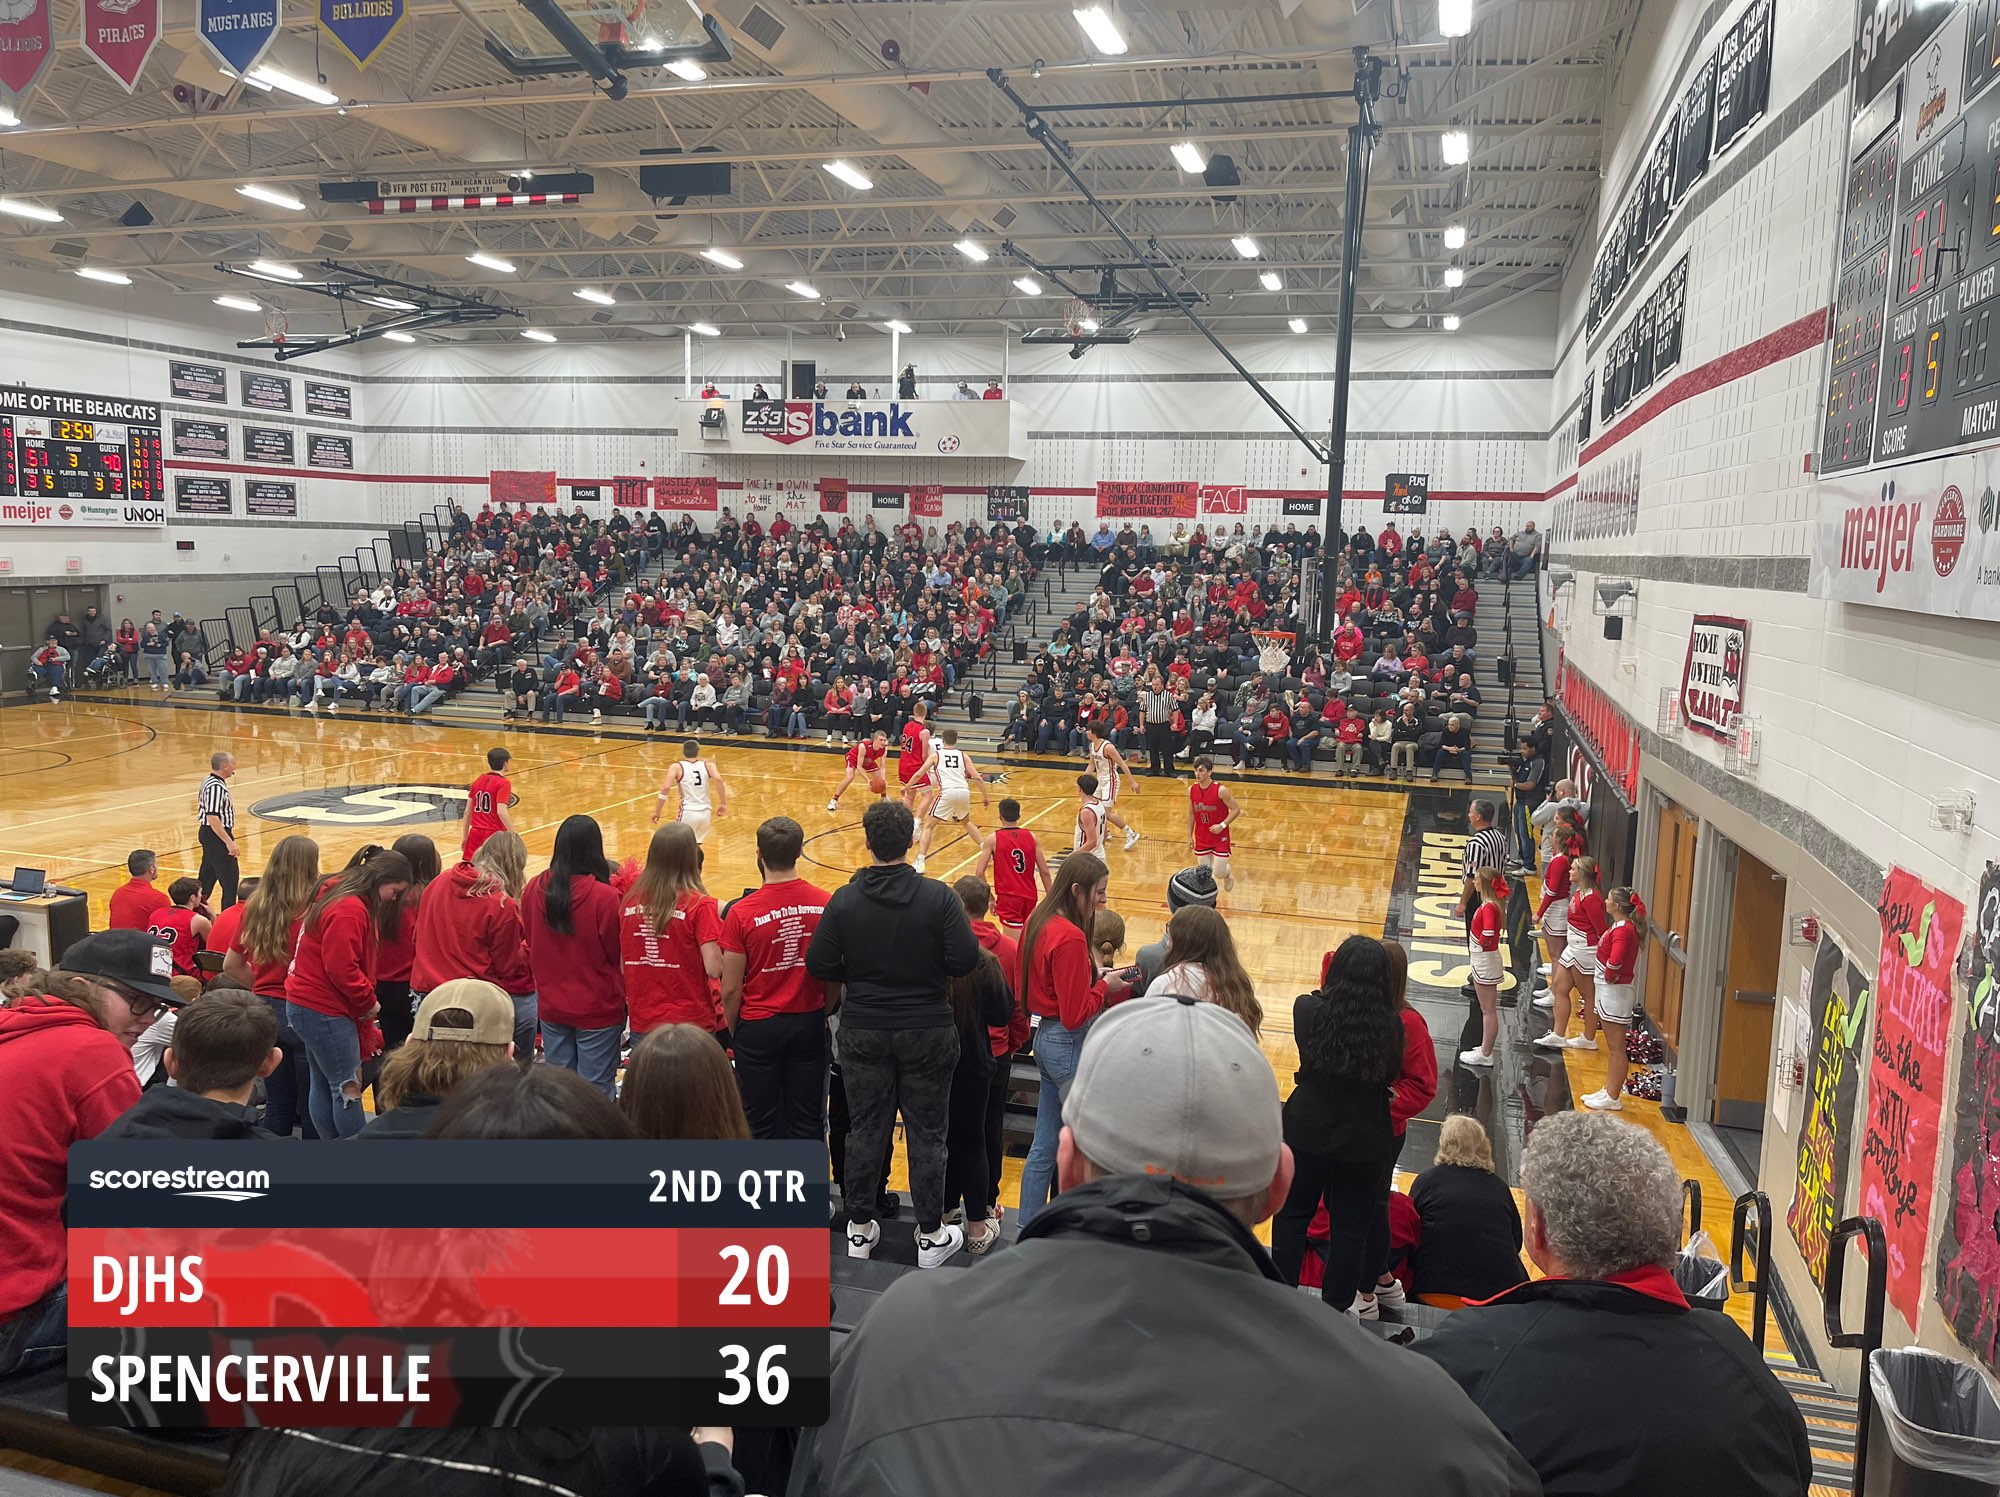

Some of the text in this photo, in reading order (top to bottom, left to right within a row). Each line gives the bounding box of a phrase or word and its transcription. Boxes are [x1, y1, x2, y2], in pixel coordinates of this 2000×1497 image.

[332, 1, 394, 21] BULLDOGS
[207, 12, 273, 33] MUSTANGS
[98, 24, 145, 43] PIRATES
[1911, 139, 1947, 201] HOME
[393, 182, 447, 193] VFW POST 6772
[450, 178, 482, 186] AMERICAN
[1958, 266, 1995, 310] PLAYER
[1893, 307, 1918, 342] FOULS
[0, 391, 157, 421] ME OF THE BEARCATS
[815, 403, 914, 437] bank
[1962, 400, 1998, 436] MATCH
[60, 421, 93, 440] 2:54
[25, 439, 45, 448] HOME
[100, 444, 120, 453] GUEST
[815, 440, 918, 450] Five Star Service Guaranteed
[1882, 425, 1908, 456] SCORE
[26, 448, 48, 467] 51
[69, 453, 78, 467] 3
[45, 475, 54, 489] 5
[95, 478, 104, 491] 3
[786, 480, 809, 490] OWN
[927, 486, 941, 494] OUT
[786, 490, 806, 500] the
[877, 497, 899, 505] HOME
[3, 501, 51, 523] meijer
[87, 506, 118, 515] Huntington
[124, 506, 164, 522] UNOH
[785, 501, 807, 509] MAT
[1102, 507, 1119, 516] BOYS
[1119, 507, 1157, 516] BASKETBALL
[1289, 503, 1314, 511] HOME
[1841, 480, 1921, 593] meijer
[1934, 523, 1963, 538] HARDWARE
[1977, 566, 1982, 585] A
[901, 734, 913, 753] 24
[945, 755, 959, 768] 23
[693, 771, 702, 786] 3
[474, 791, 491, 813] 10
[1011, 848, 1026, 874] 3
[754, 914, 772, 927] THANK
[1877, 880, 1913, 957] hey
[1897, 1034, 1922, 1092] the
[1877, 1079, 1910, 1154] WIN
[1863, 1127, 1917, 1229] goodbye
